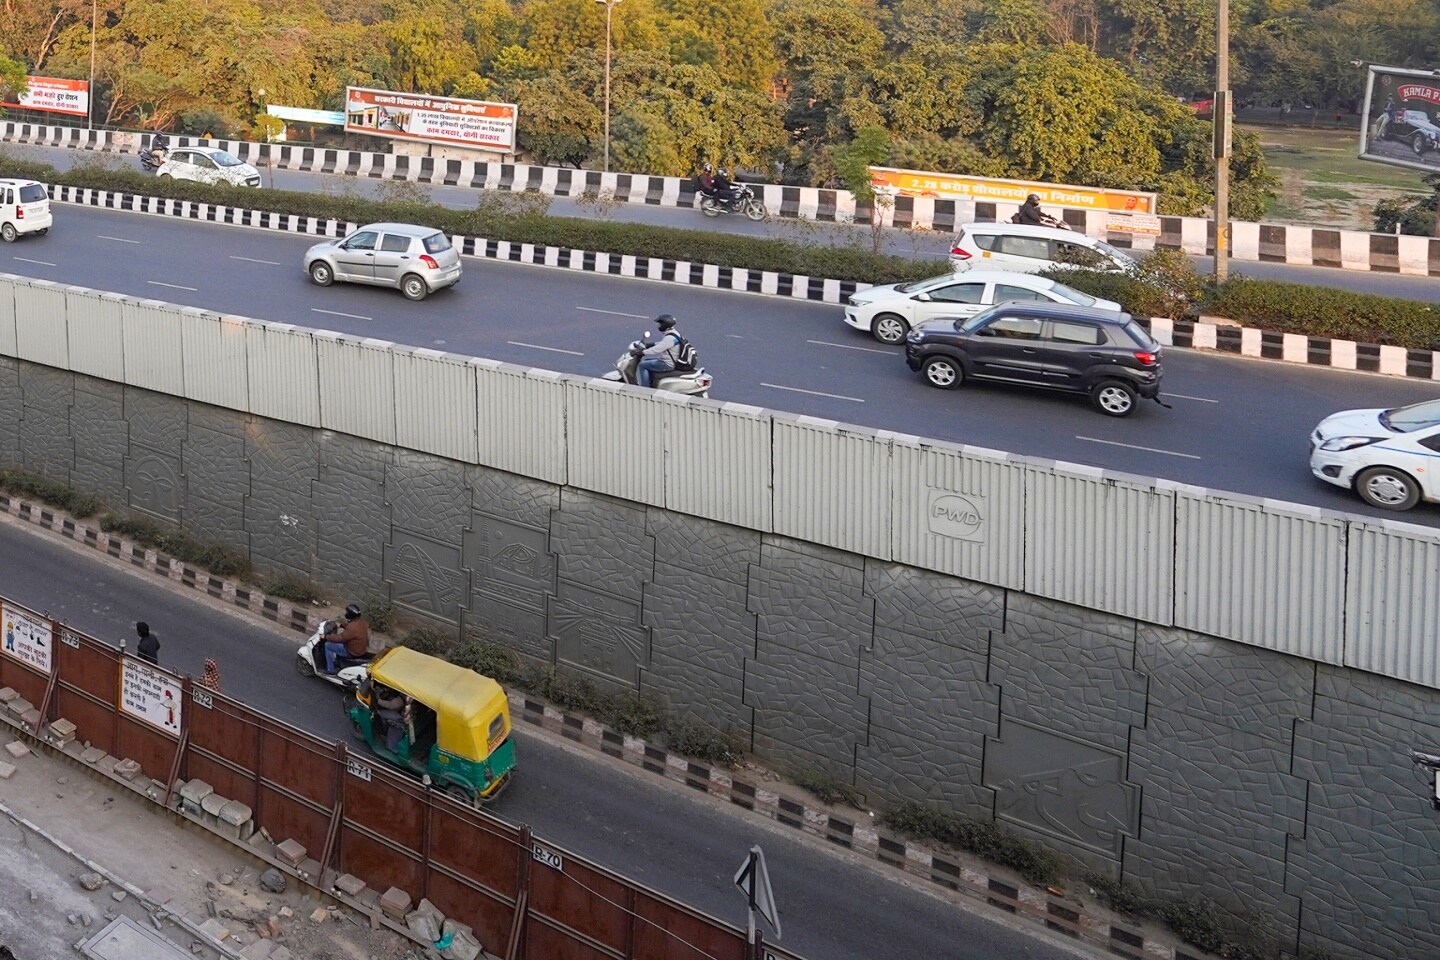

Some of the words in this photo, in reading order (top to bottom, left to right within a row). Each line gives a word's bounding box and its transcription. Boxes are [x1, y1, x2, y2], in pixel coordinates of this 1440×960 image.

[1403, 87, 1431, 99] KAMLA
[1050, 190, 1095, 204] निर्माण
[932, 505, 980, 526] PWD
[535, 846, 561, 867] R-70
